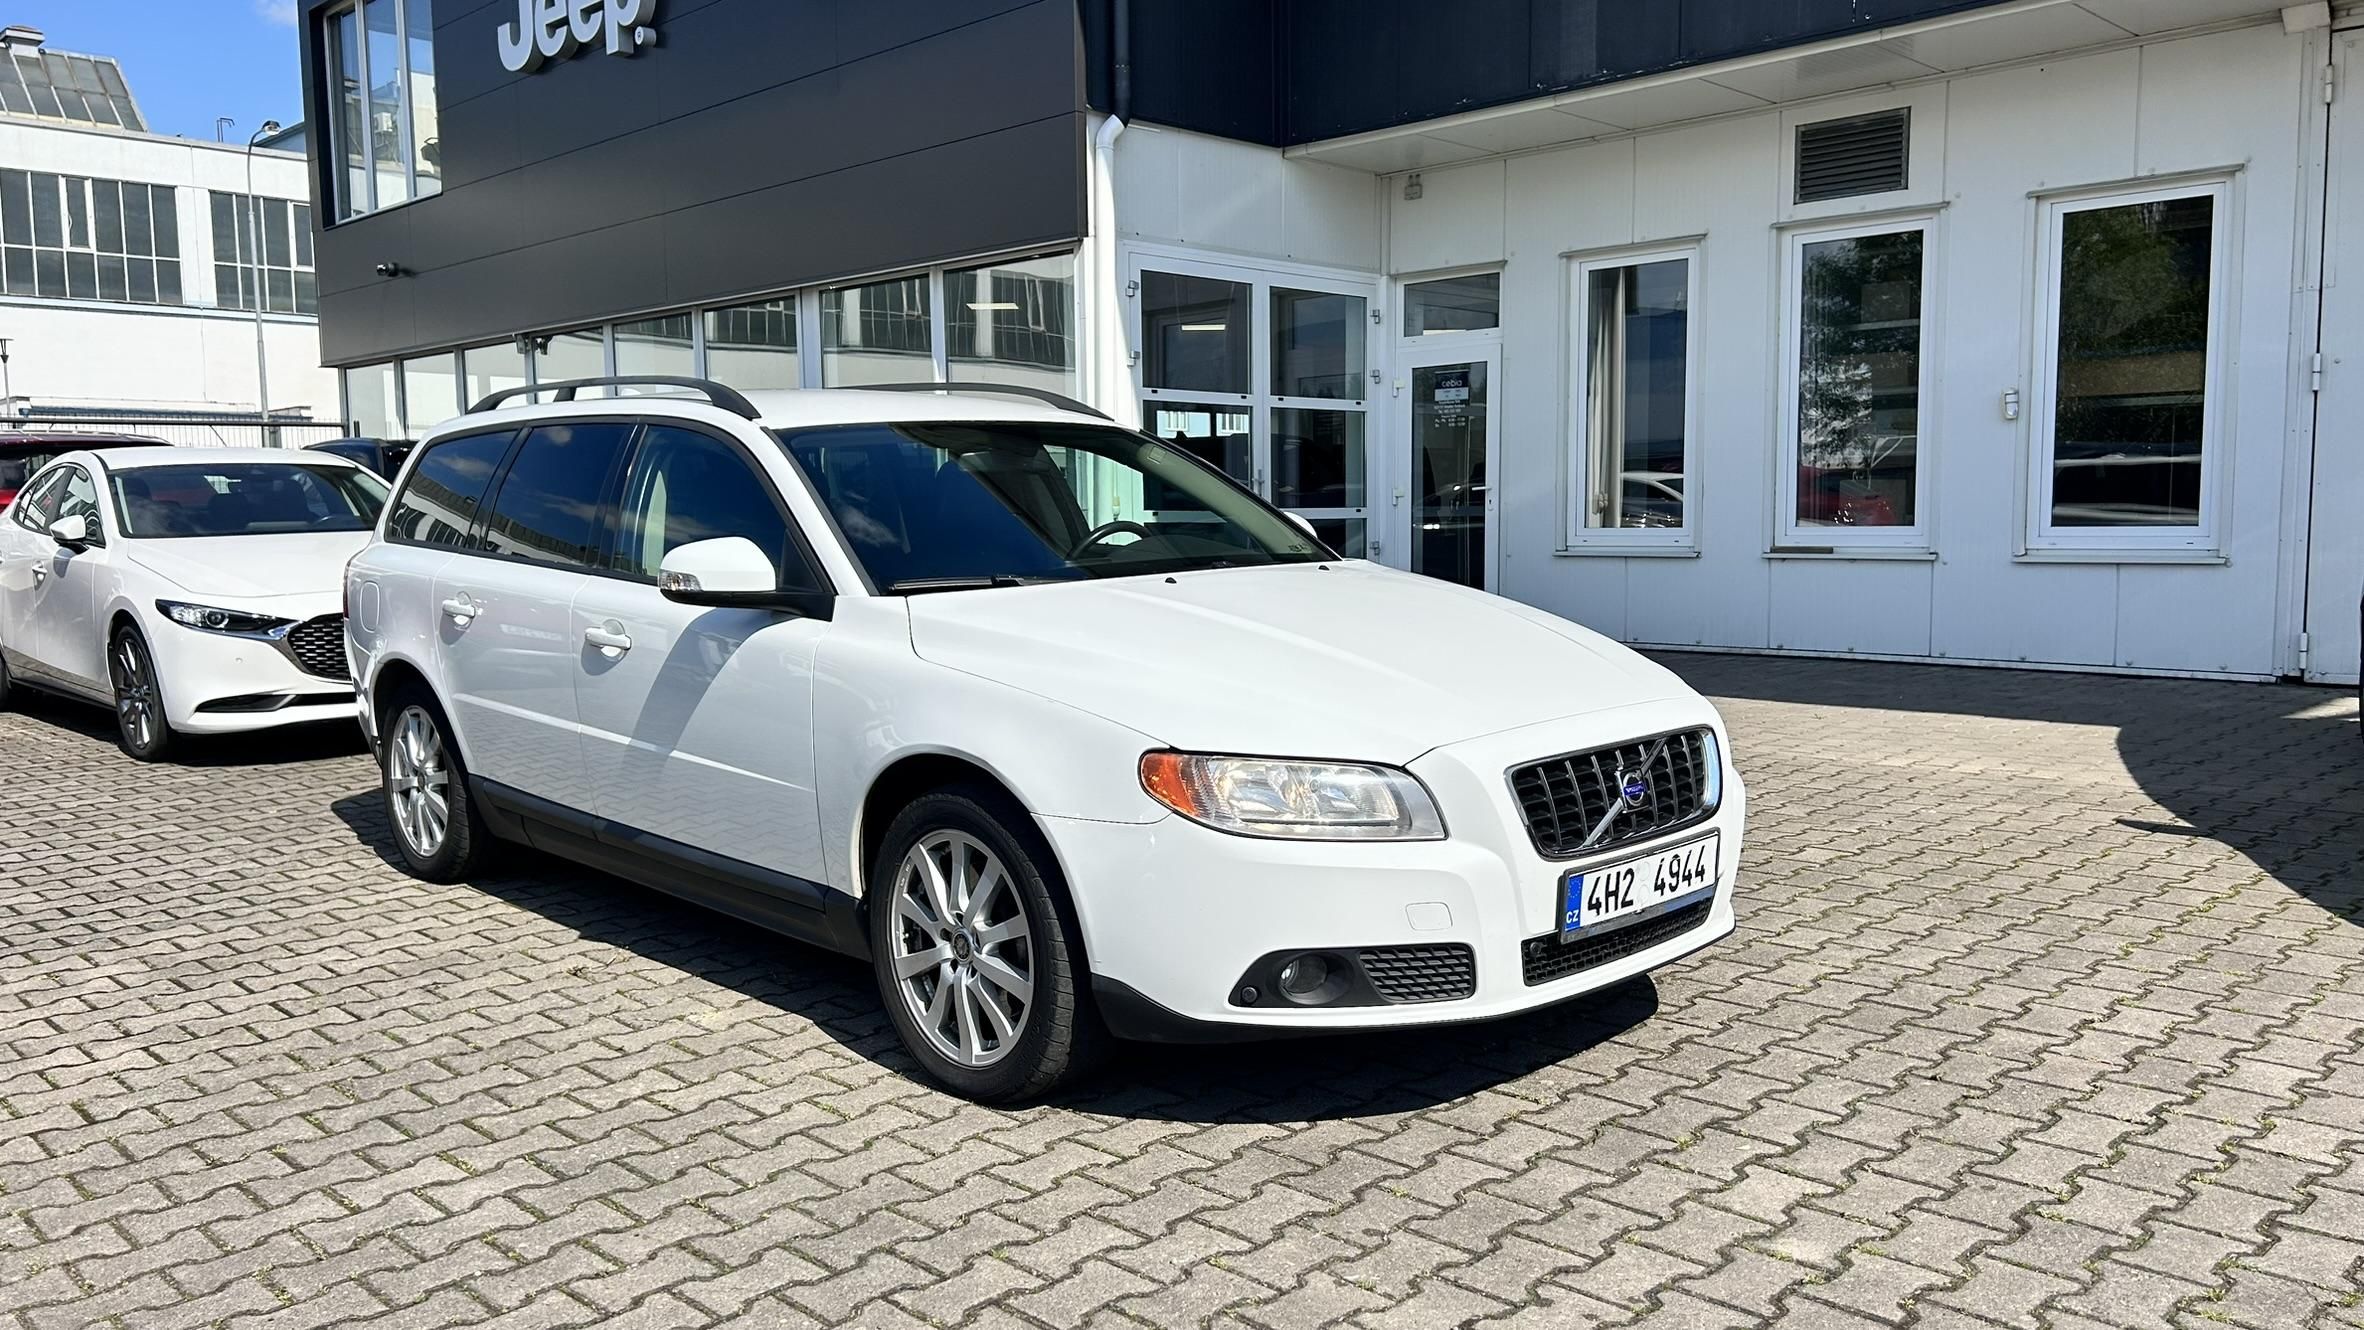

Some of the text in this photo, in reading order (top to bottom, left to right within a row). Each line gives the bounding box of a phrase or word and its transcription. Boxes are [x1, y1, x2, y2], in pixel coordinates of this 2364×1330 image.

[1587, 845, 1706, 917] 4H2 4944
[1566, 909, 1579, 924] CZ
